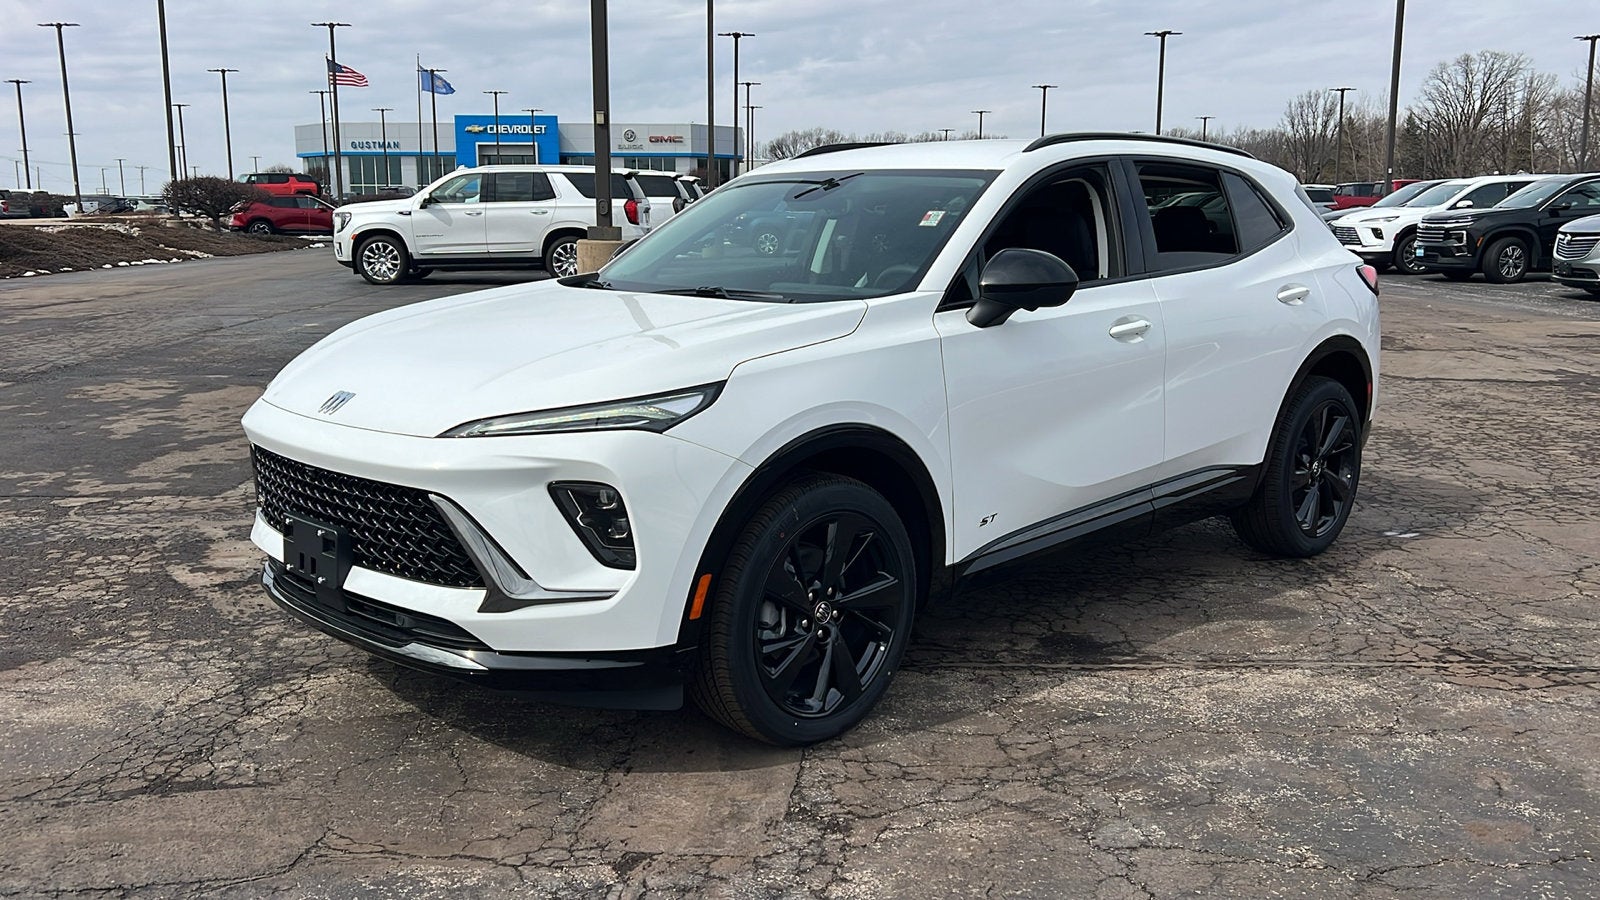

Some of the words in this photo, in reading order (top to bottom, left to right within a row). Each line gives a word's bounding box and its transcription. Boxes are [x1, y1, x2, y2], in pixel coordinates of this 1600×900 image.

[487, 125, 546, 134] CHEVROLET
[351, 141, 399, 149] GUSTMAN
[979, 513, 997, 527] ST
